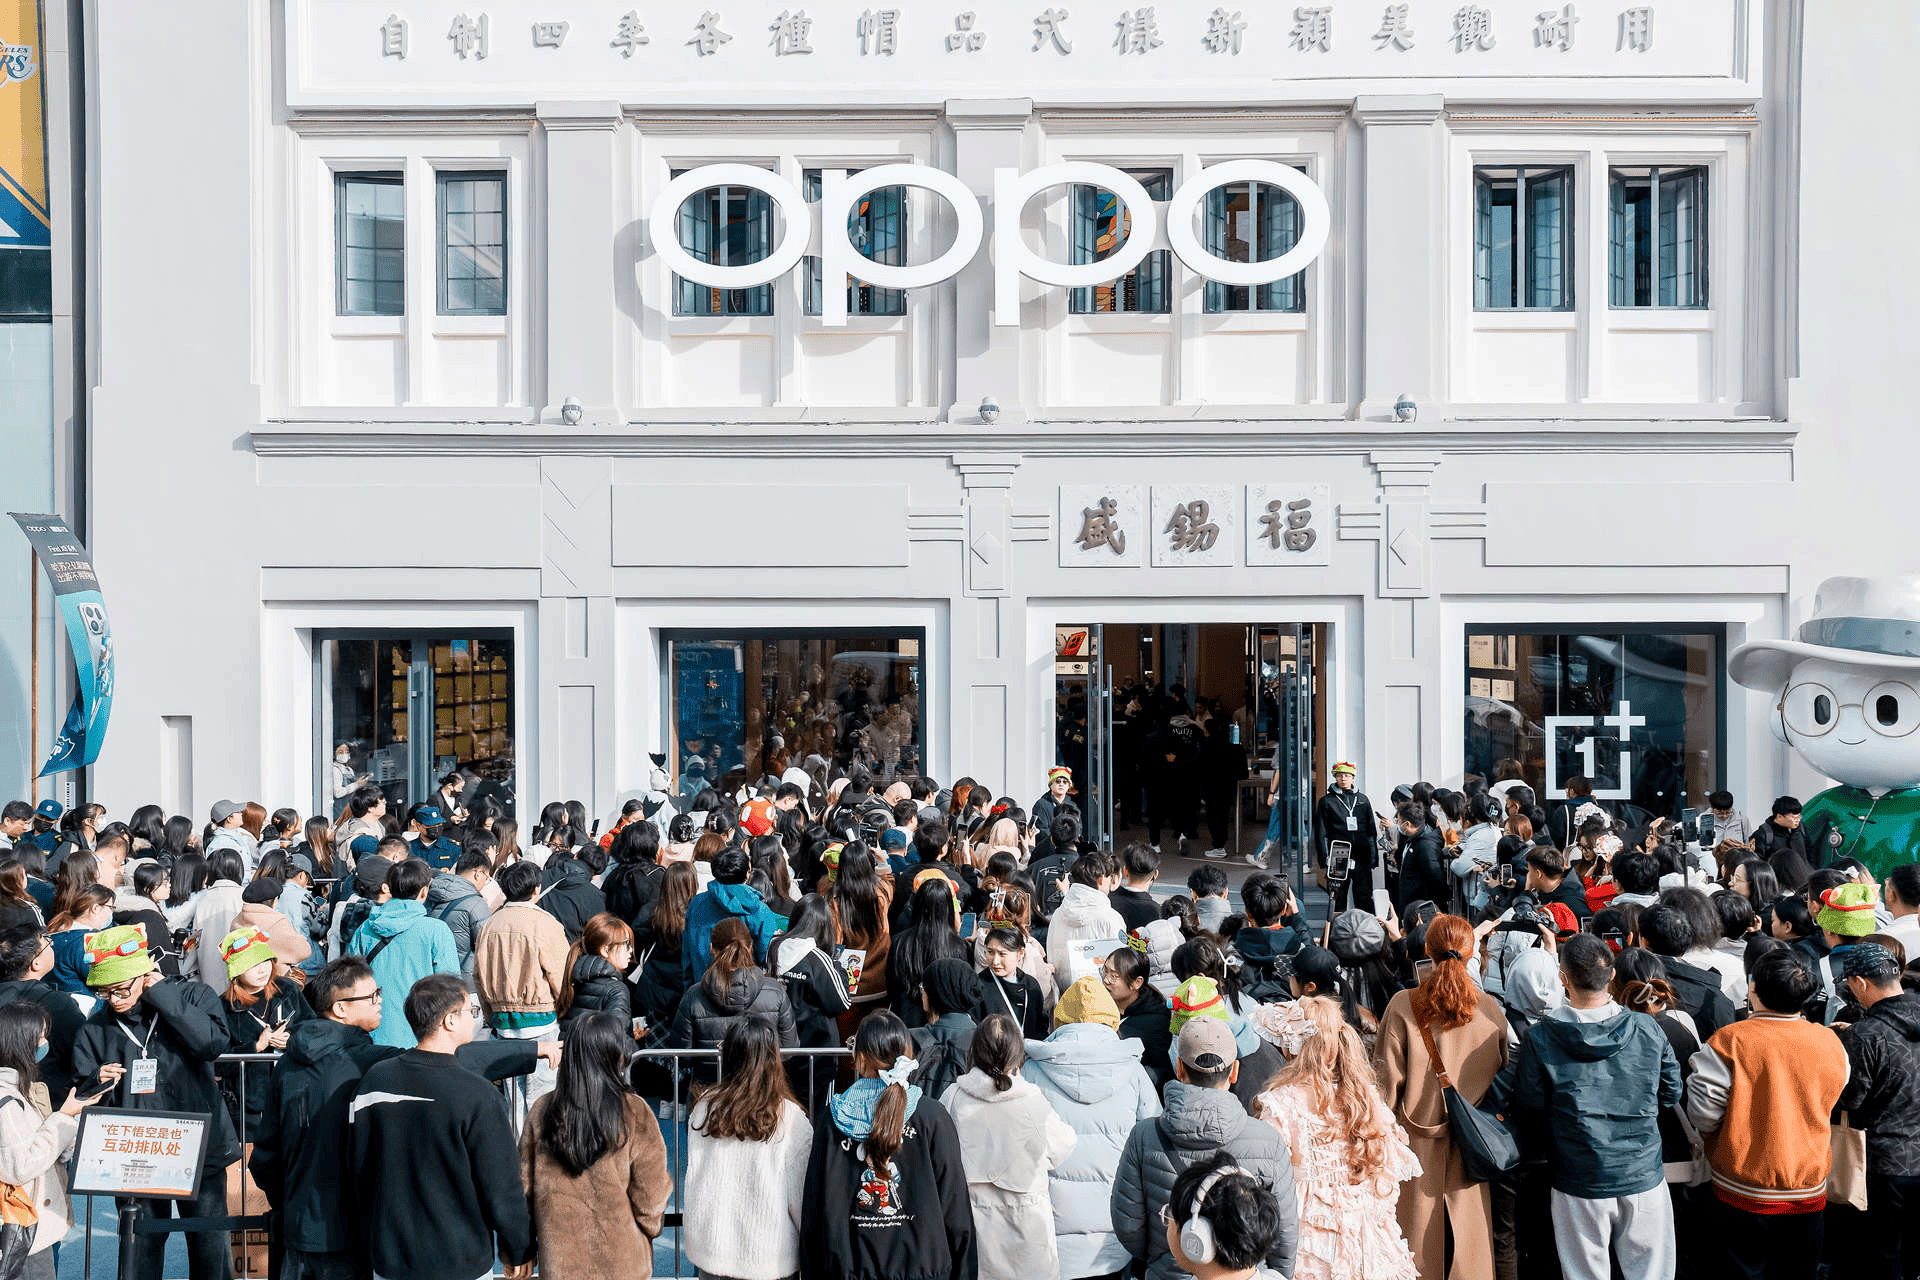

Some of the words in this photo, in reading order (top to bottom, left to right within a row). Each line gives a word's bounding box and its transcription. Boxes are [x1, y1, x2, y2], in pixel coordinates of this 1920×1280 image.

[101, 1138, 182, 1157] 互动排队处
